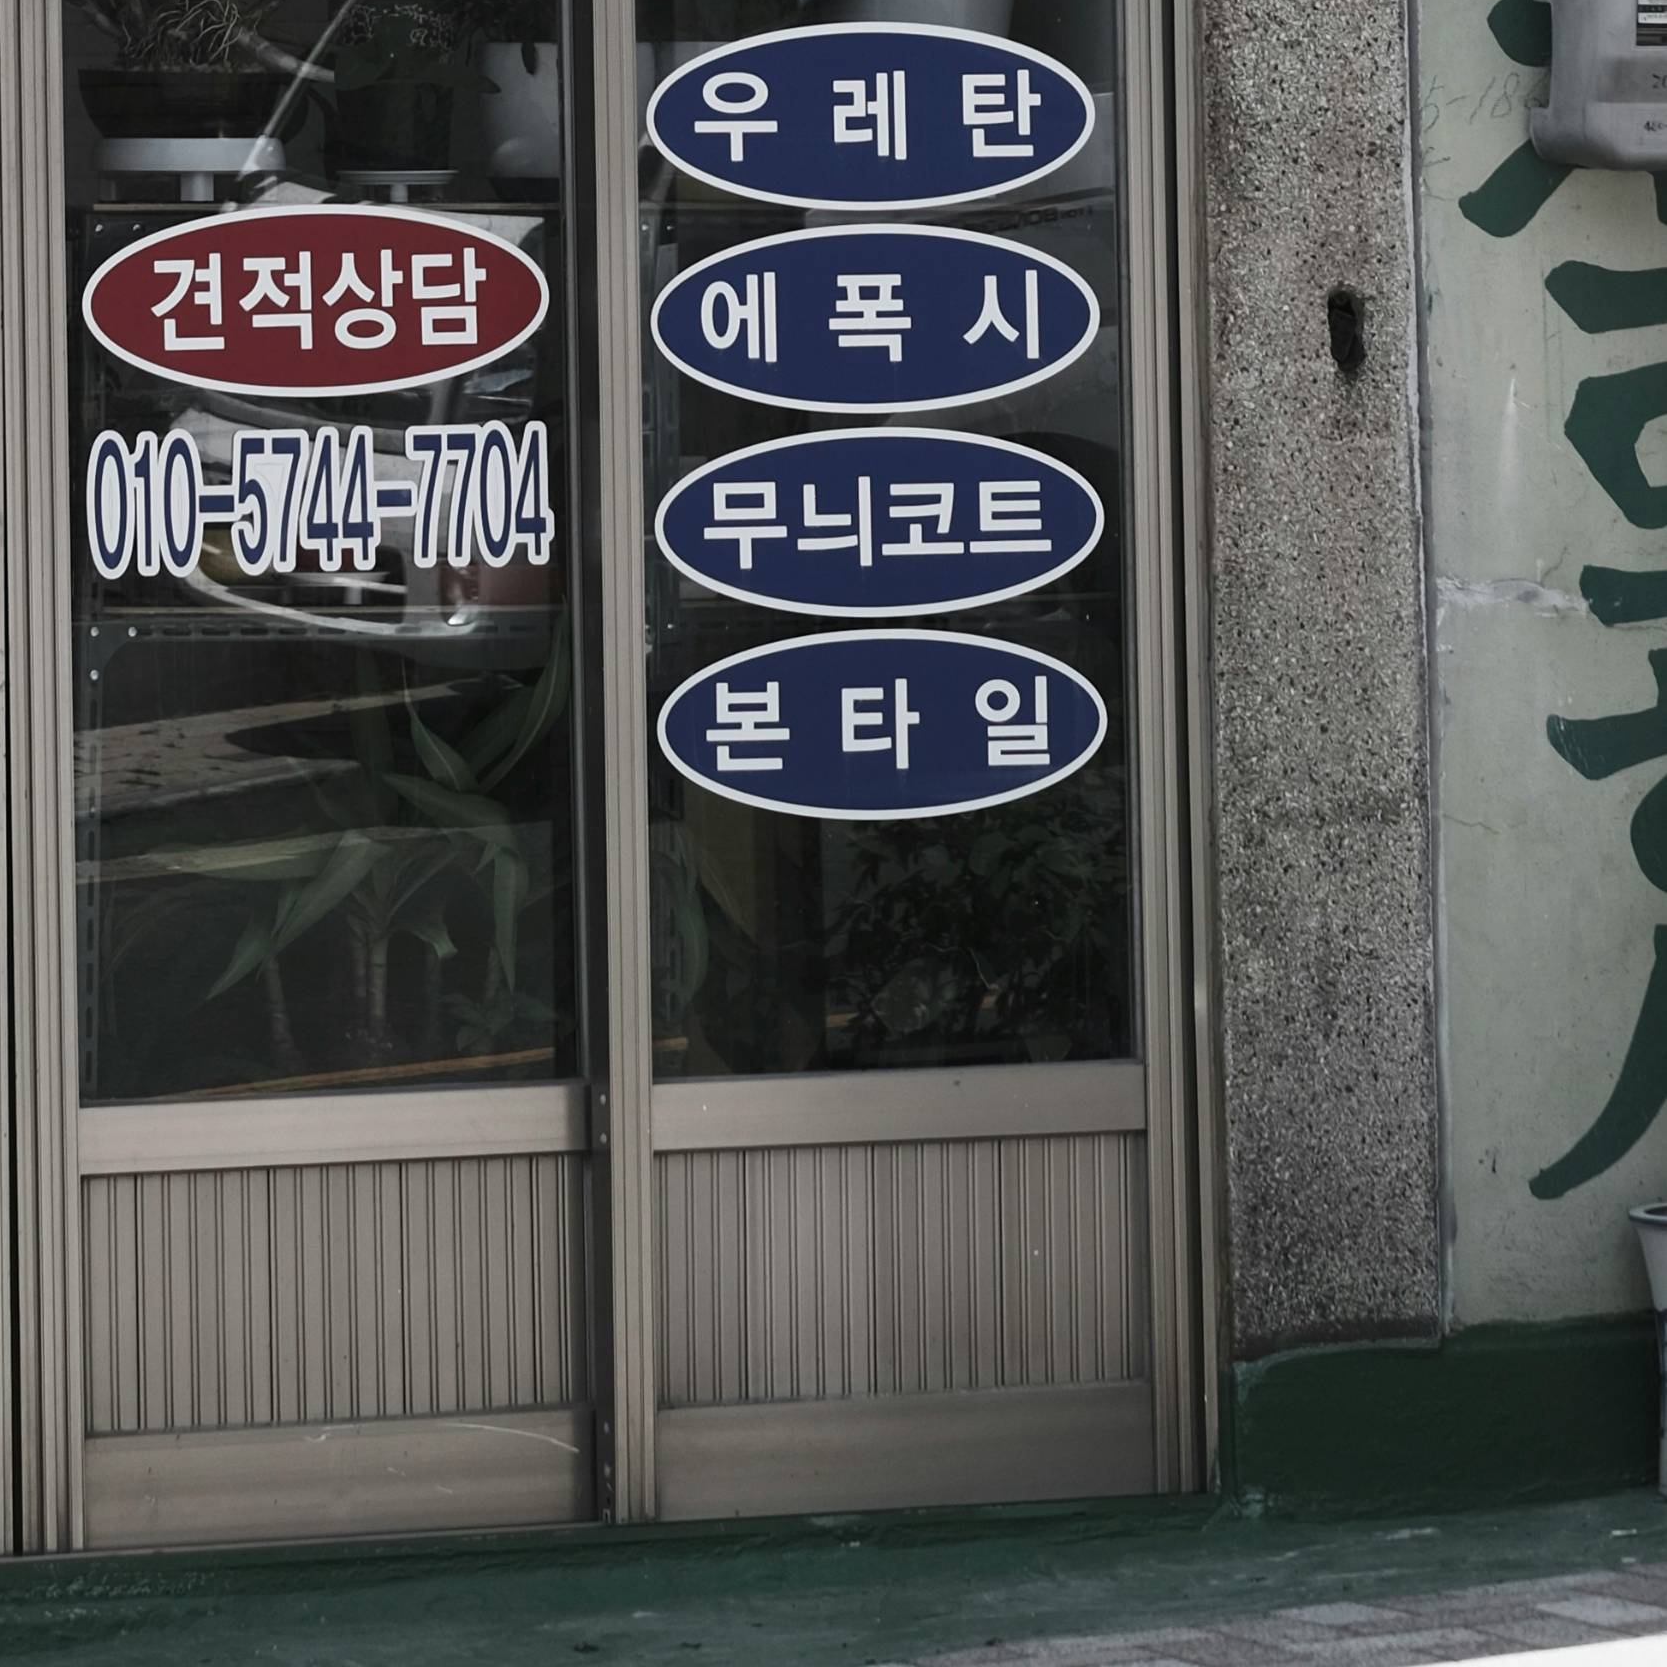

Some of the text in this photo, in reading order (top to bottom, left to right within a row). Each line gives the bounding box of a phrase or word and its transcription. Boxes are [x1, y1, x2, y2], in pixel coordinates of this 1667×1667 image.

[693, 69, 1042, 163] 우레탄
[150, 247, 487, 352] 견적상담
[699, 269, 1042, 363] 에폭시
[86, 420, 554, 580] 010-5744-7704
[703, 476, 1053, 570] 무늬코트
[706, 675, 1050, 772] 본타일
